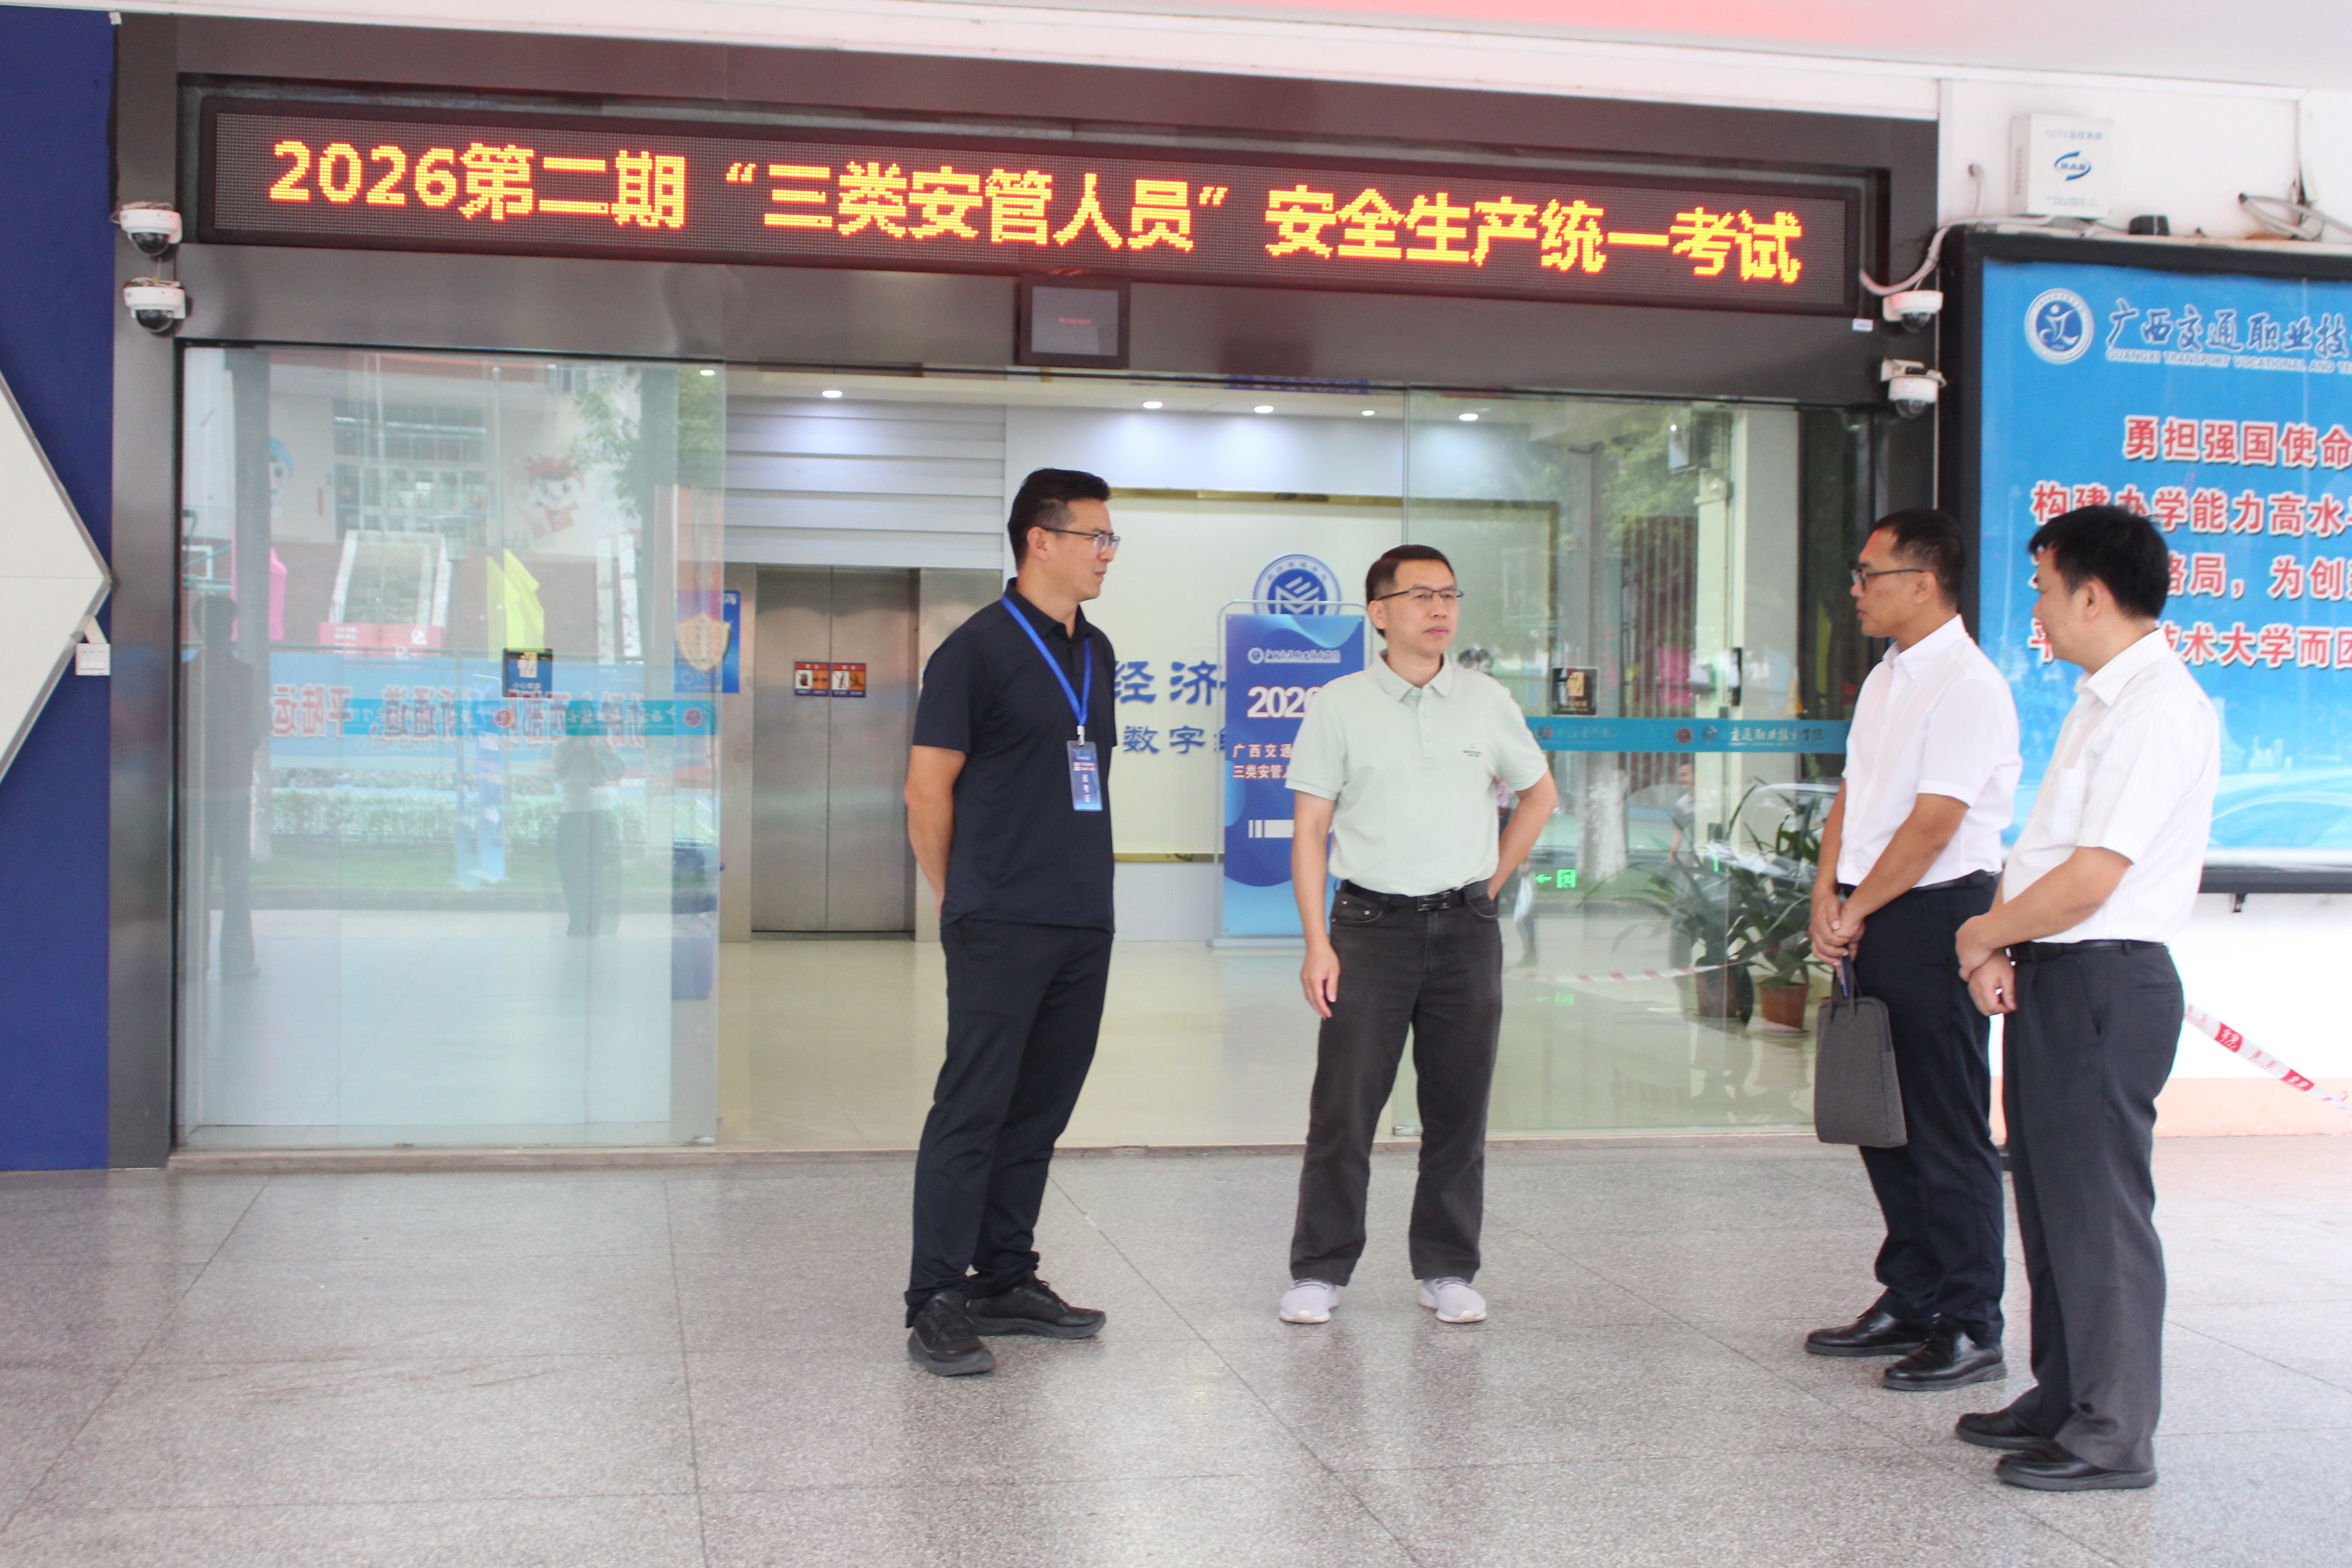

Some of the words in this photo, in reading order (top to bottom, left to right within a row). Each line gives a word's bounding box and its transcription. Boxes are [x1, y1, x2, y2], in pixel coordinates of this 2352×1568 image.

[2124, 415, 2352, 470] 勇担强国使命
